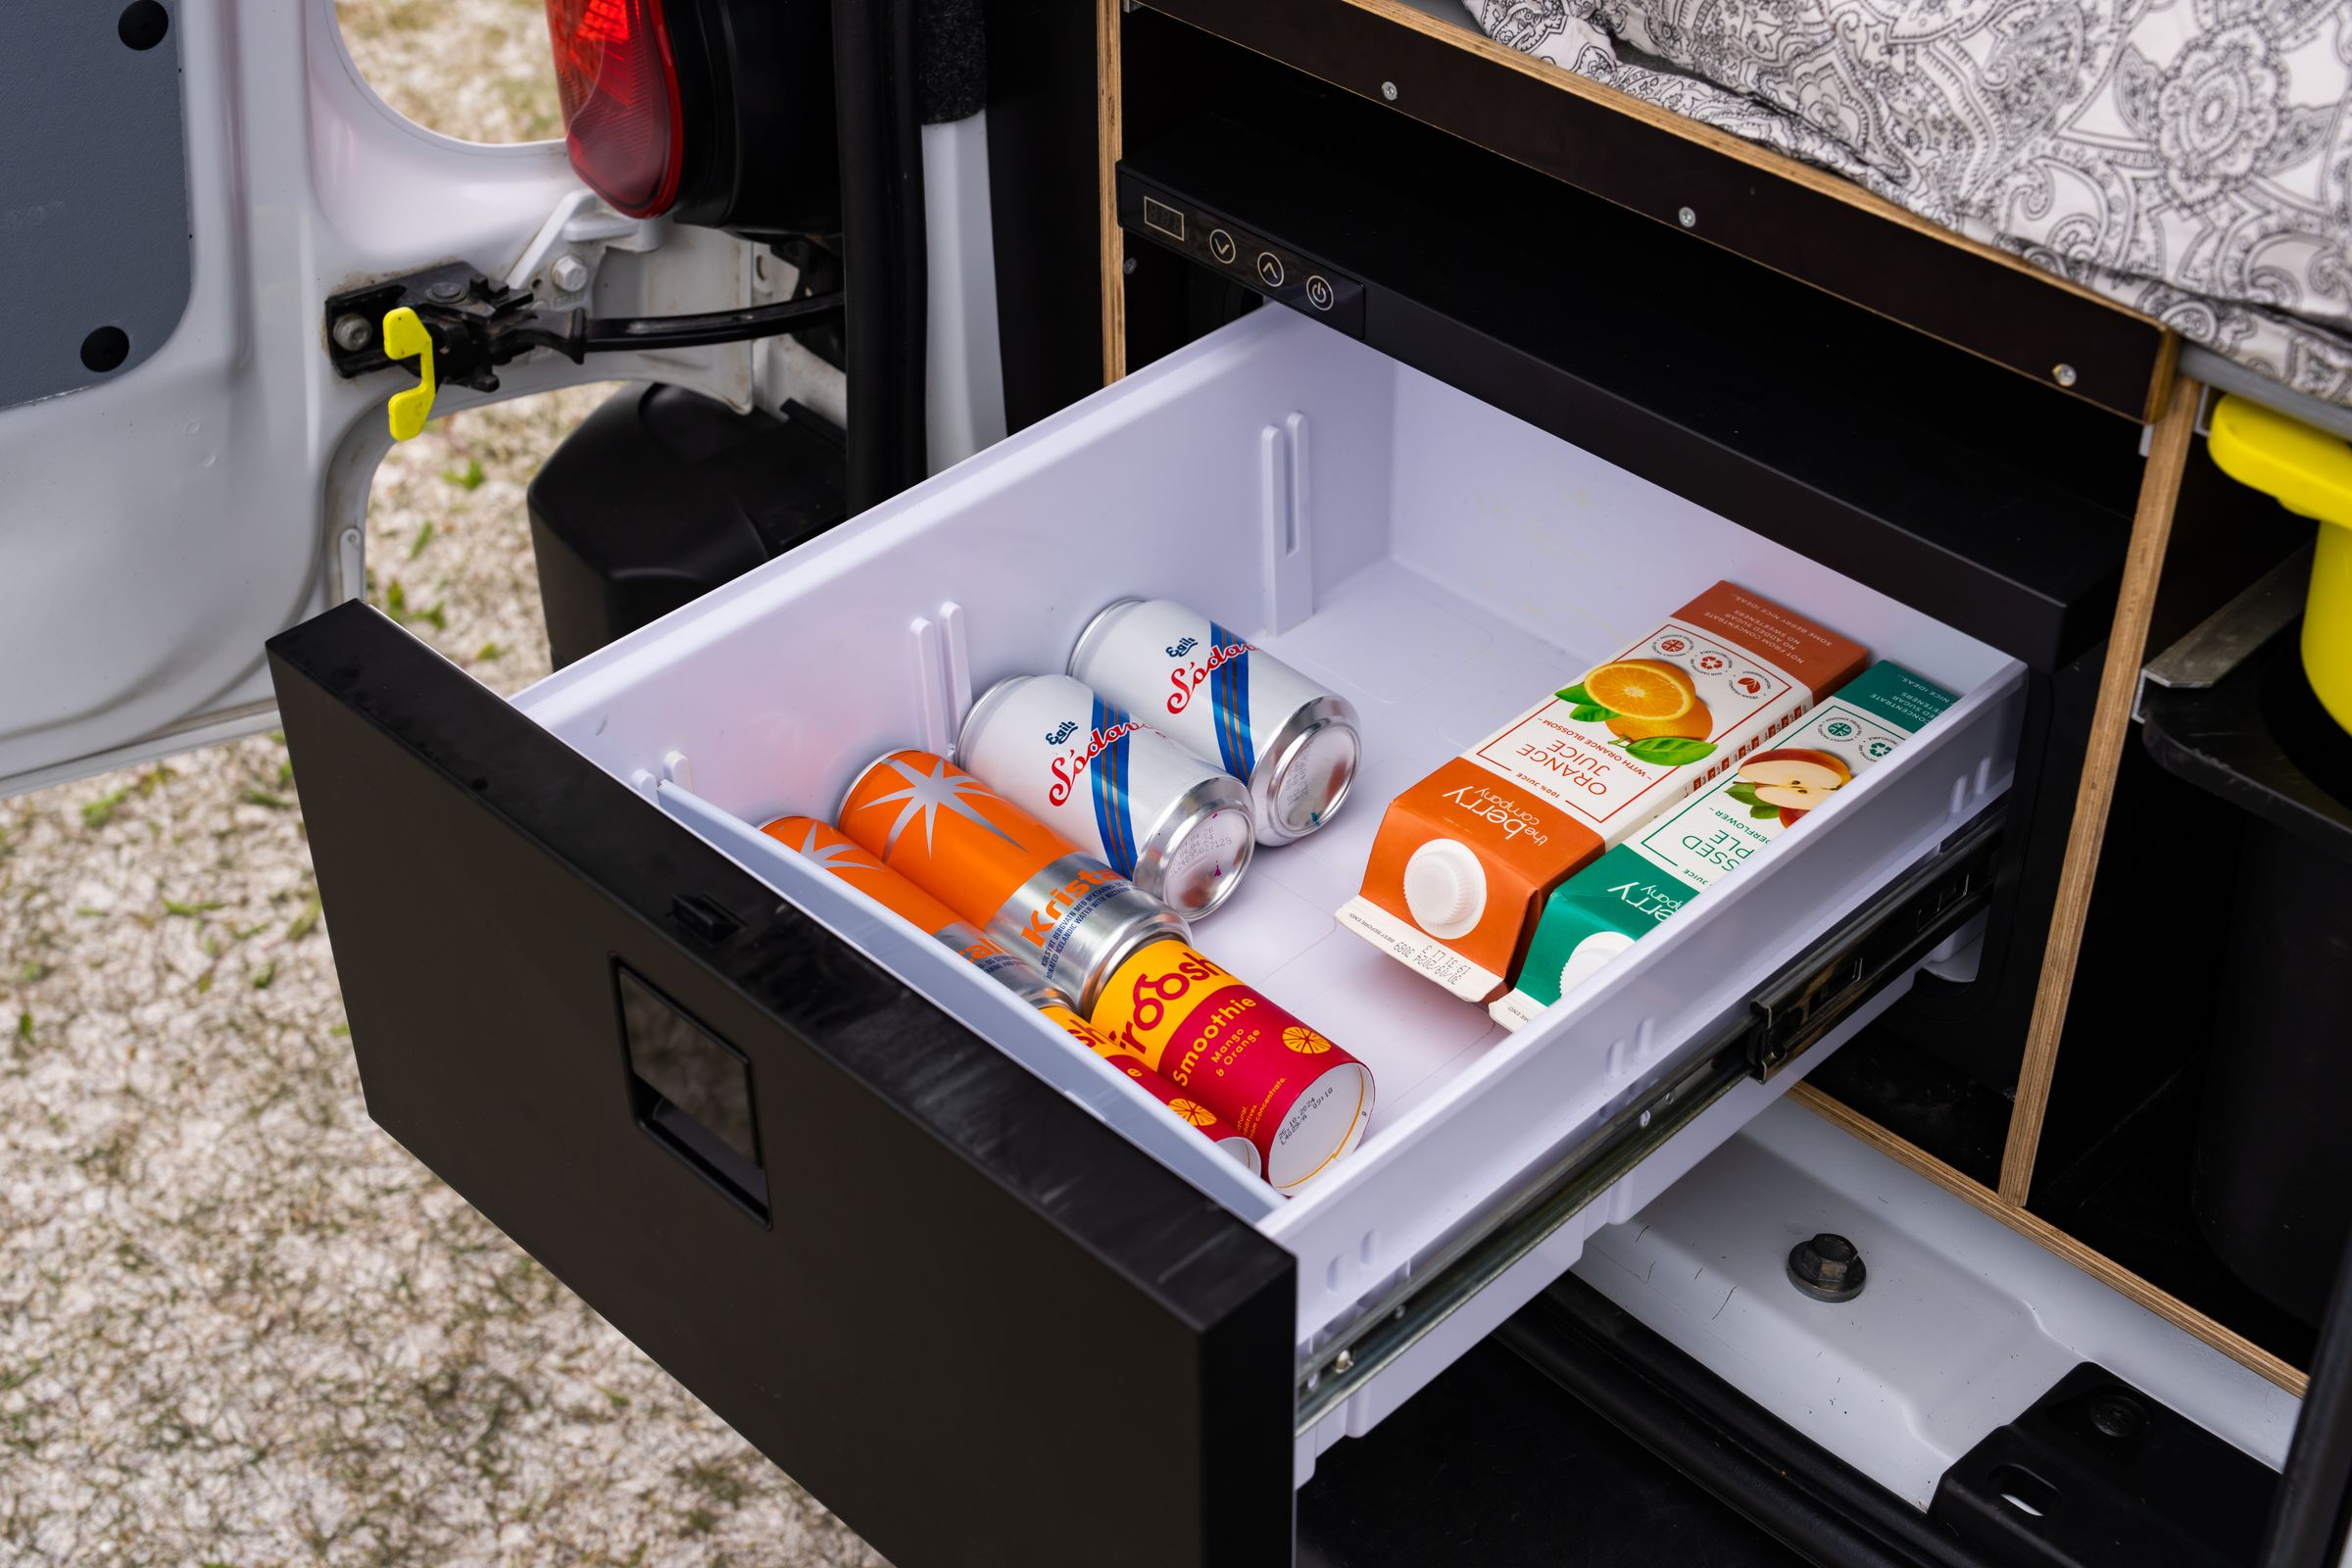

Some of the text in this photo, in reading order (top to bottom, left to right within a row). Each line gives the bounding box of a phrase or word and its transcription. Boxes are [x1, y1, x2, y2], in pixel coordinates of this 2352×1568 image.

[1725, 612, 1796, 651] NO ADDED SUGAR
[1733, 609, 1801, 646] NO SWEETENERS
[1761, 608, 1781, 620] NICE
[1781, 618, 1808, 634] BERRY
[1703, 611, 1804, 664] NOT FROM CONCENTRATE
[1808, 631, 1833, 647] SOME
[1891, 696, 1923, 712] SUGAR
[1929, 690, 1950, 703] NICE
[1045, 720, 1079, 746] Egils
[1542, 718, 1647, 777] WITH ORANGE BLOSSOM
[1515, 743, 1608, 796] ORANGE
[1545, 739, 1611, 777] JUICE
[1515, 772, 1561, 799] 100% JUICE
[1442, 785, 1548, 847] the berry
[1474, 787, 1541, 825] company
[1682, 835, 1740, 872] SSED
[1708, 829, 1755, 859] PLE
[1682, 868, 1709, 886] JUICE
[1054, 910, 1077, 940] BERGVATN
[1074, 899, 1088, 914] MED
[1606, 881, 1675, 922] erry
[1056, 923, 1078, 955] ICELANDIC
[1075, 906, 1094, 924] WATER
[1092, 895, 1107, 908] WITH
[1360, 921, 1382, 937] BEFORE
[1380, 932, 1396, 944] BEST
[1172, 998, 1257, 1087] Smoothie
[1210, 1028, 1245, 1063] Mango
[1223, 1029, 1260, 1065] Orange
[1237, 1105, 1249, 1131] atural.
[1255, 1077, 1287, 1122] concentrate.
[1278, 1097, 1316, 1140] 25.10.2024
